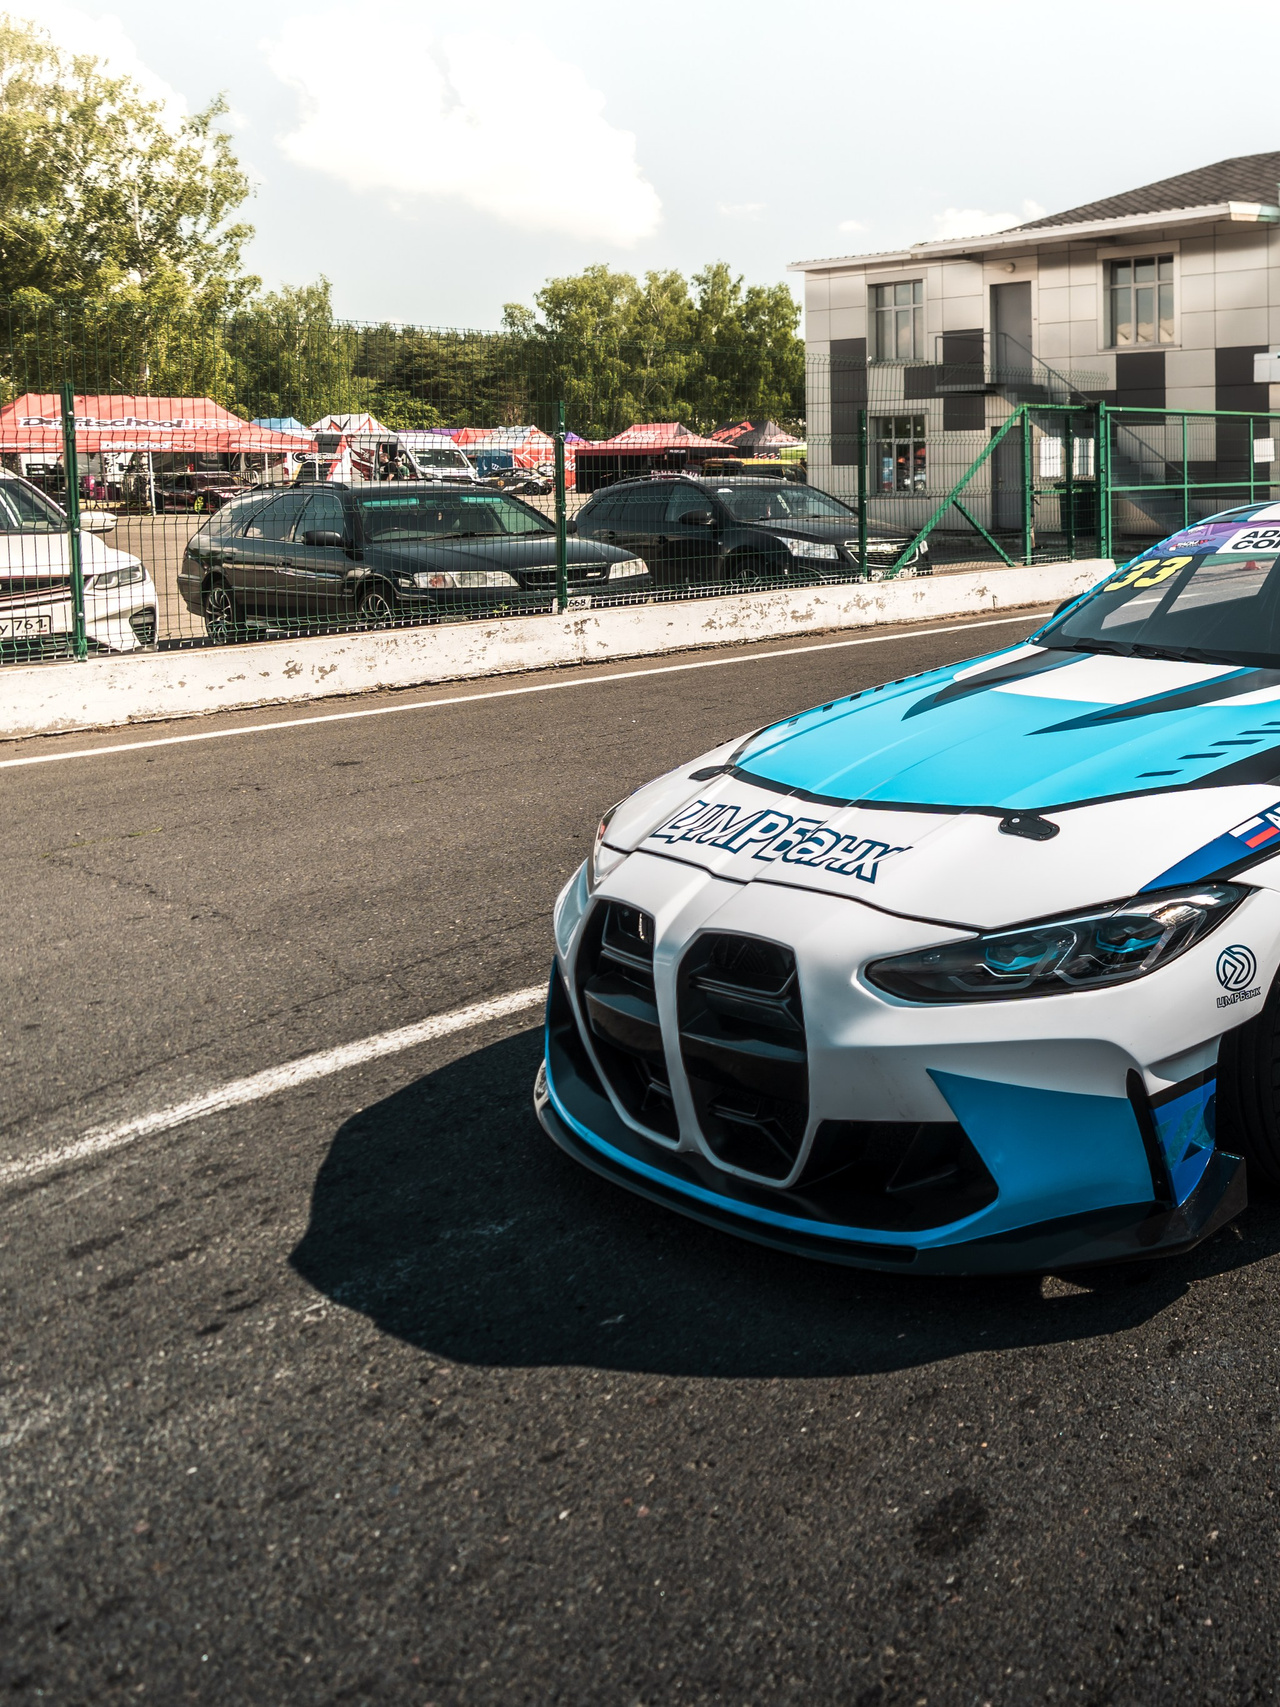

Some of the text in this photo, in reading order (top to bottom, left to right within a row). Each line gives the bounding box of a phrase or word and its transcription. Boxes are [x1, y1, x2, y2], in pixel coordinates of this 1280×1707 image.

[1103, 556, 1193, 592] 33
[649, 799, 914, 884] ЦМРБанк
[1216, 986, 1261, 1009] ЦМРБанк
